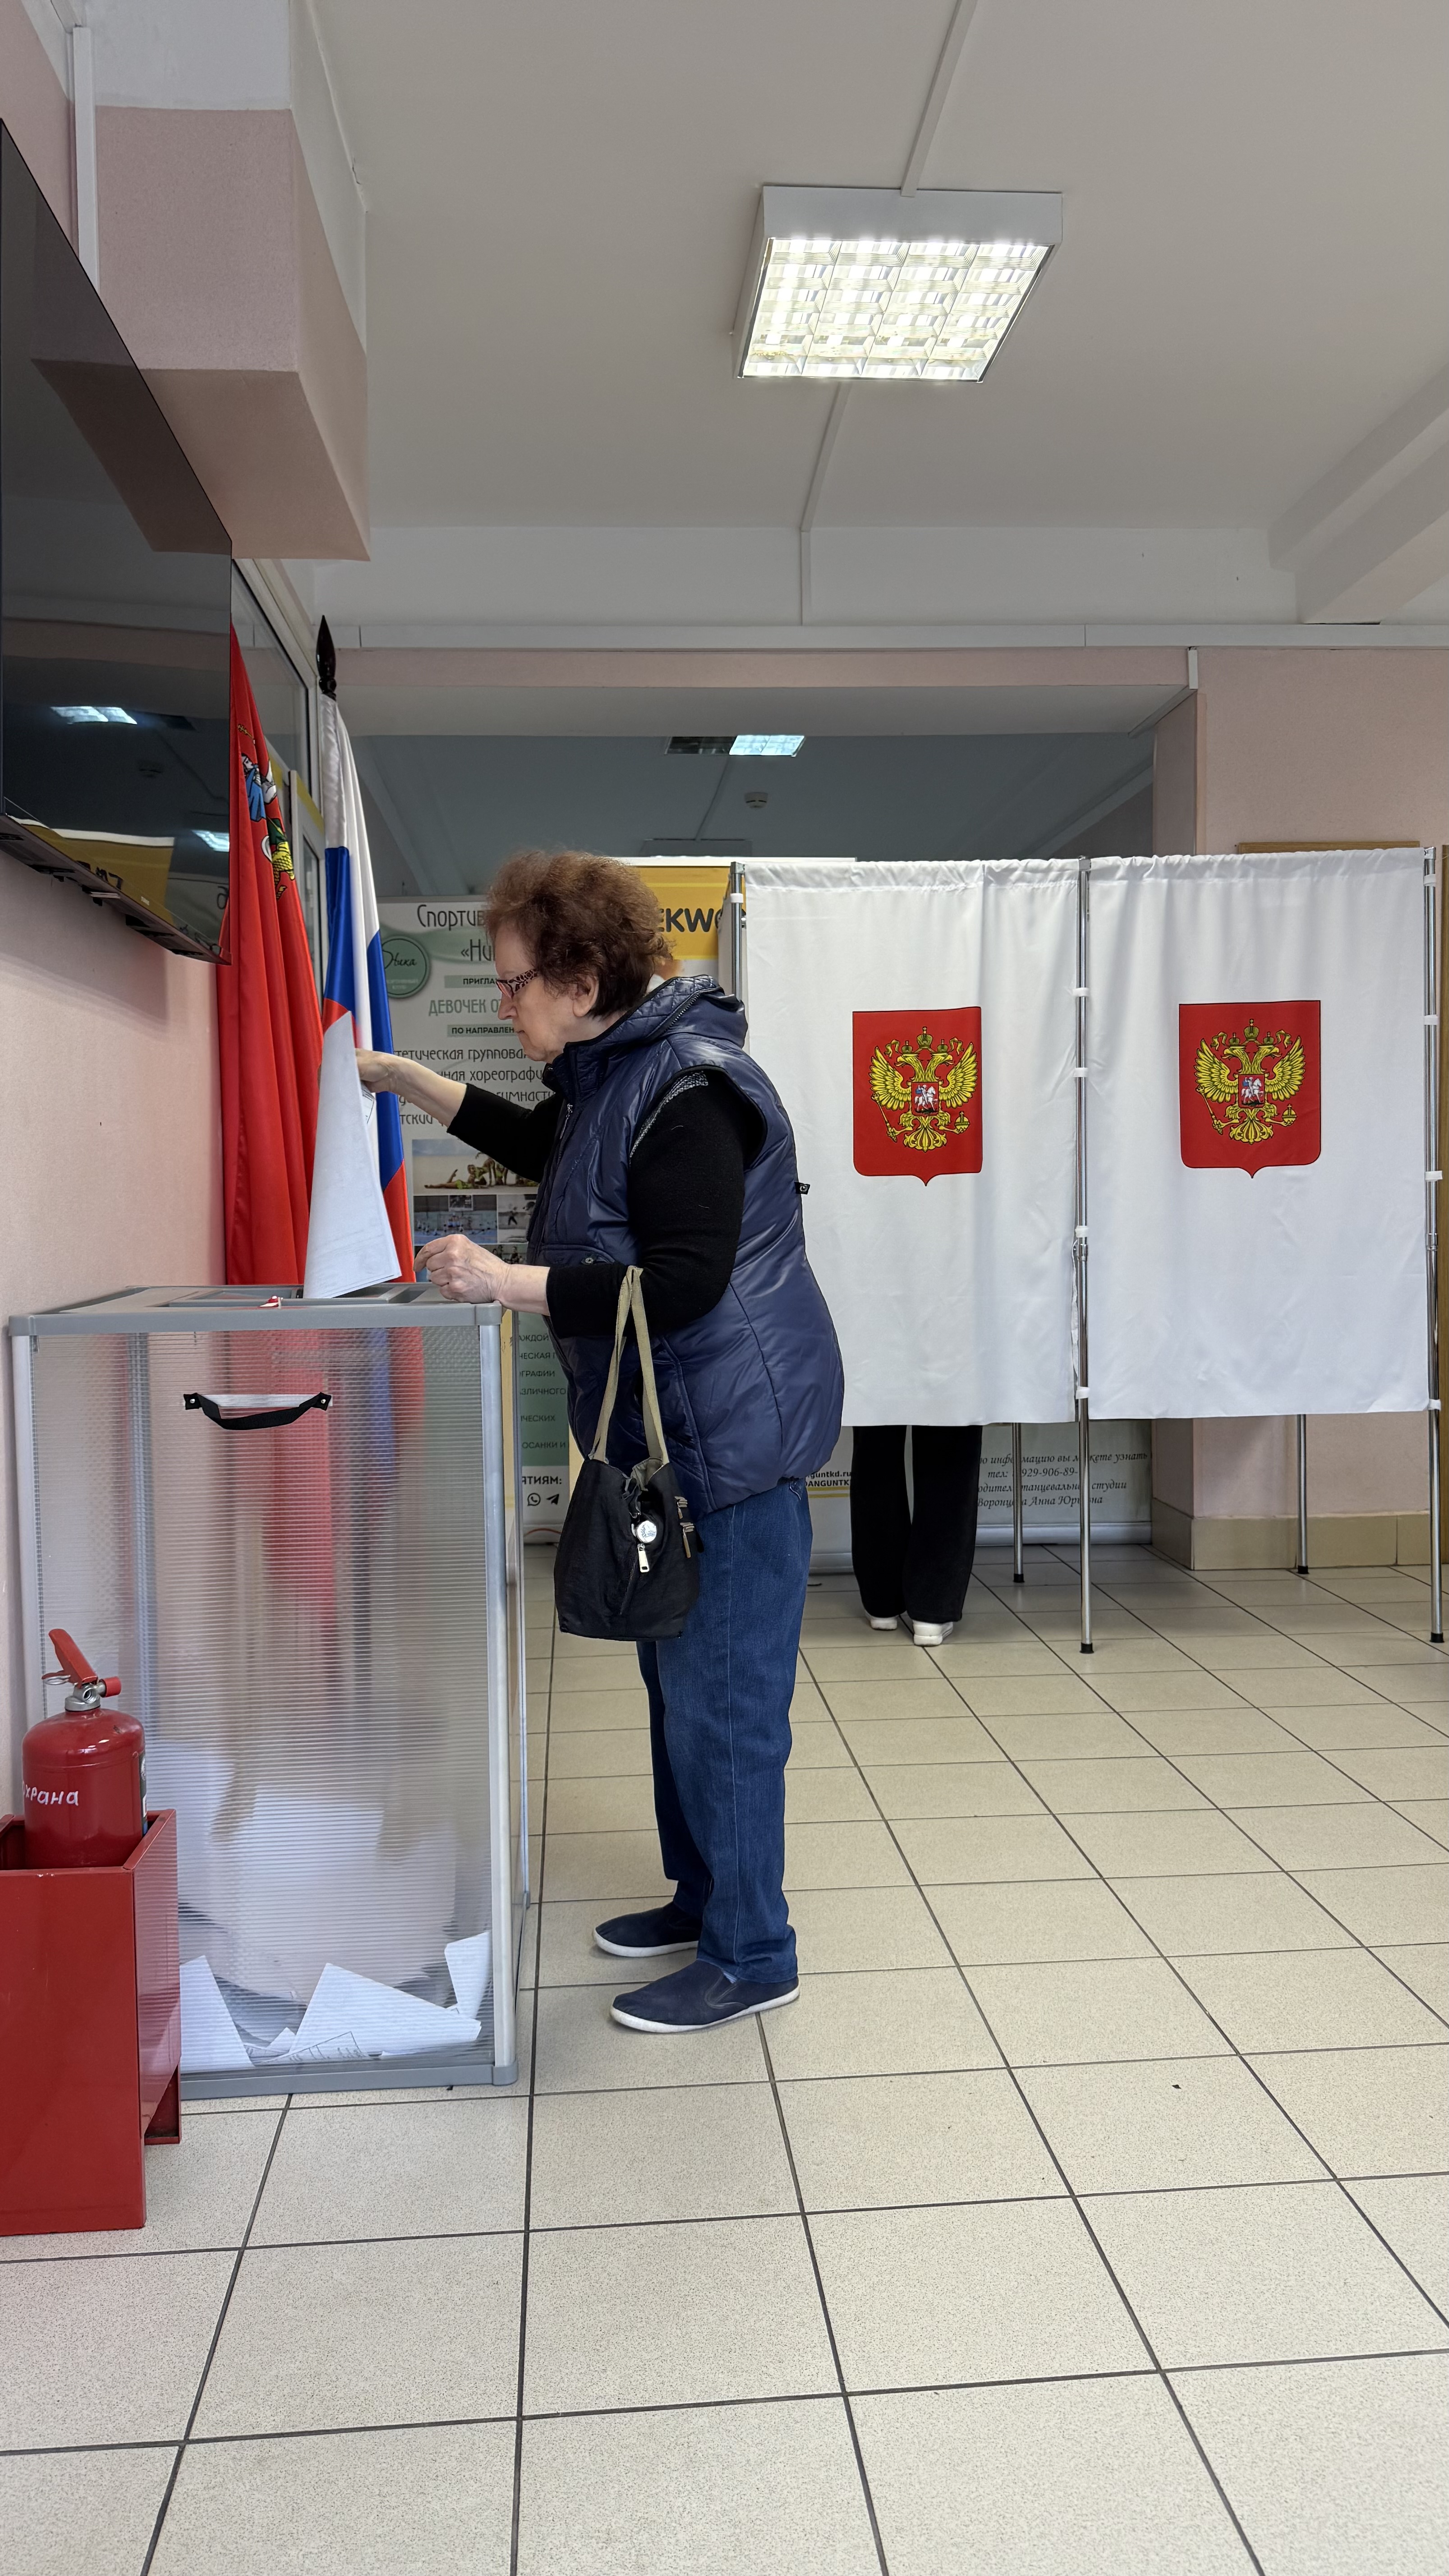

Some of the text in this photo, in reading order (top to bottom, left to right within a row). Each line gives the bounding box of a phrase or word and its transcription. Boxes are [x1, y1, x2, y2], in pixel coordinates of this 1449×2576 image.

[461, 939, 495, 961] «Ни
[428, 999, 487, 1016] ДЕВОЧЕК
[991, 1454, 1054, 1466] инфмацию
[1113, 1453, 1148, 1464] узнать
[1092, 1479, 1127, 1492] студии
[1029, 1496, 1055, 1507] Анна
